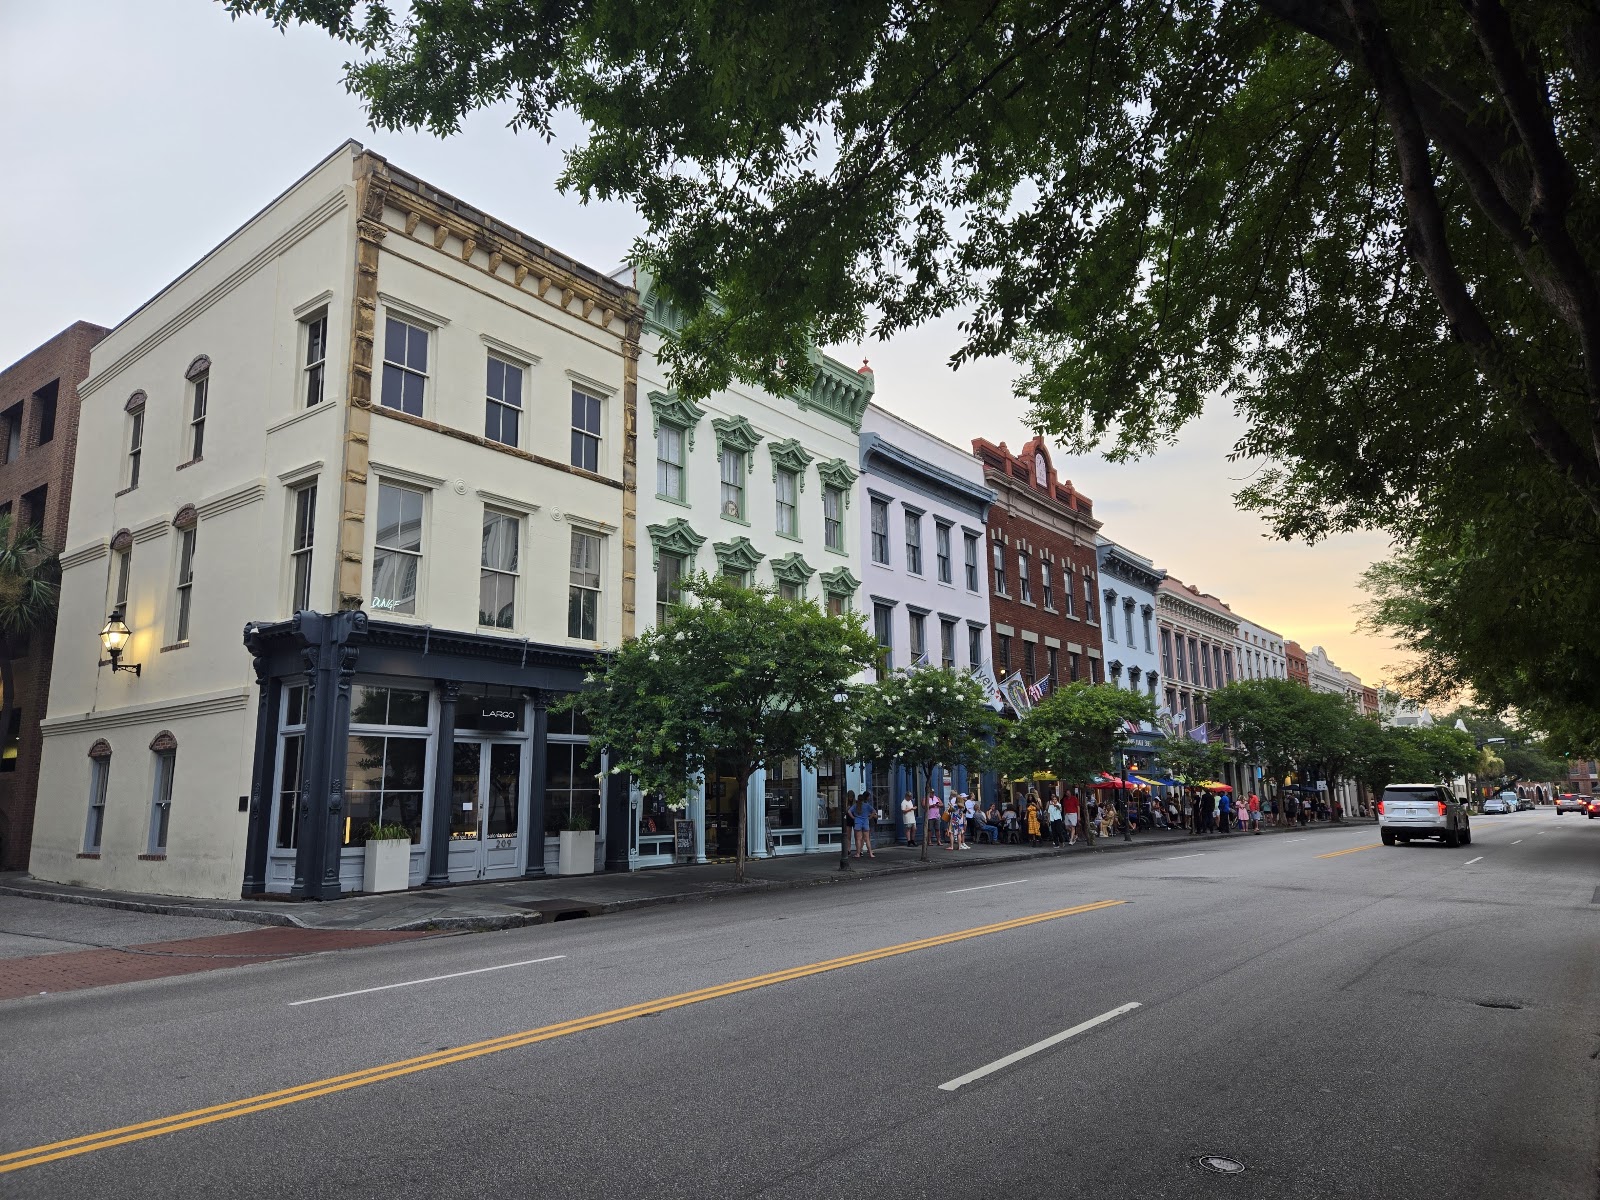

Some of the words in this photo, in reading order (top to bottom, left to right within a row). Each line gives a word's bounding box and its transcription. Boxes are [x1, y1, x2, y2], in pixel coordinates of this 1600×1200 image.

[975, 671, 996, 696] yelp
[482, 710, 515, 719] LARGO
[496, 839, 512, 848] 209
